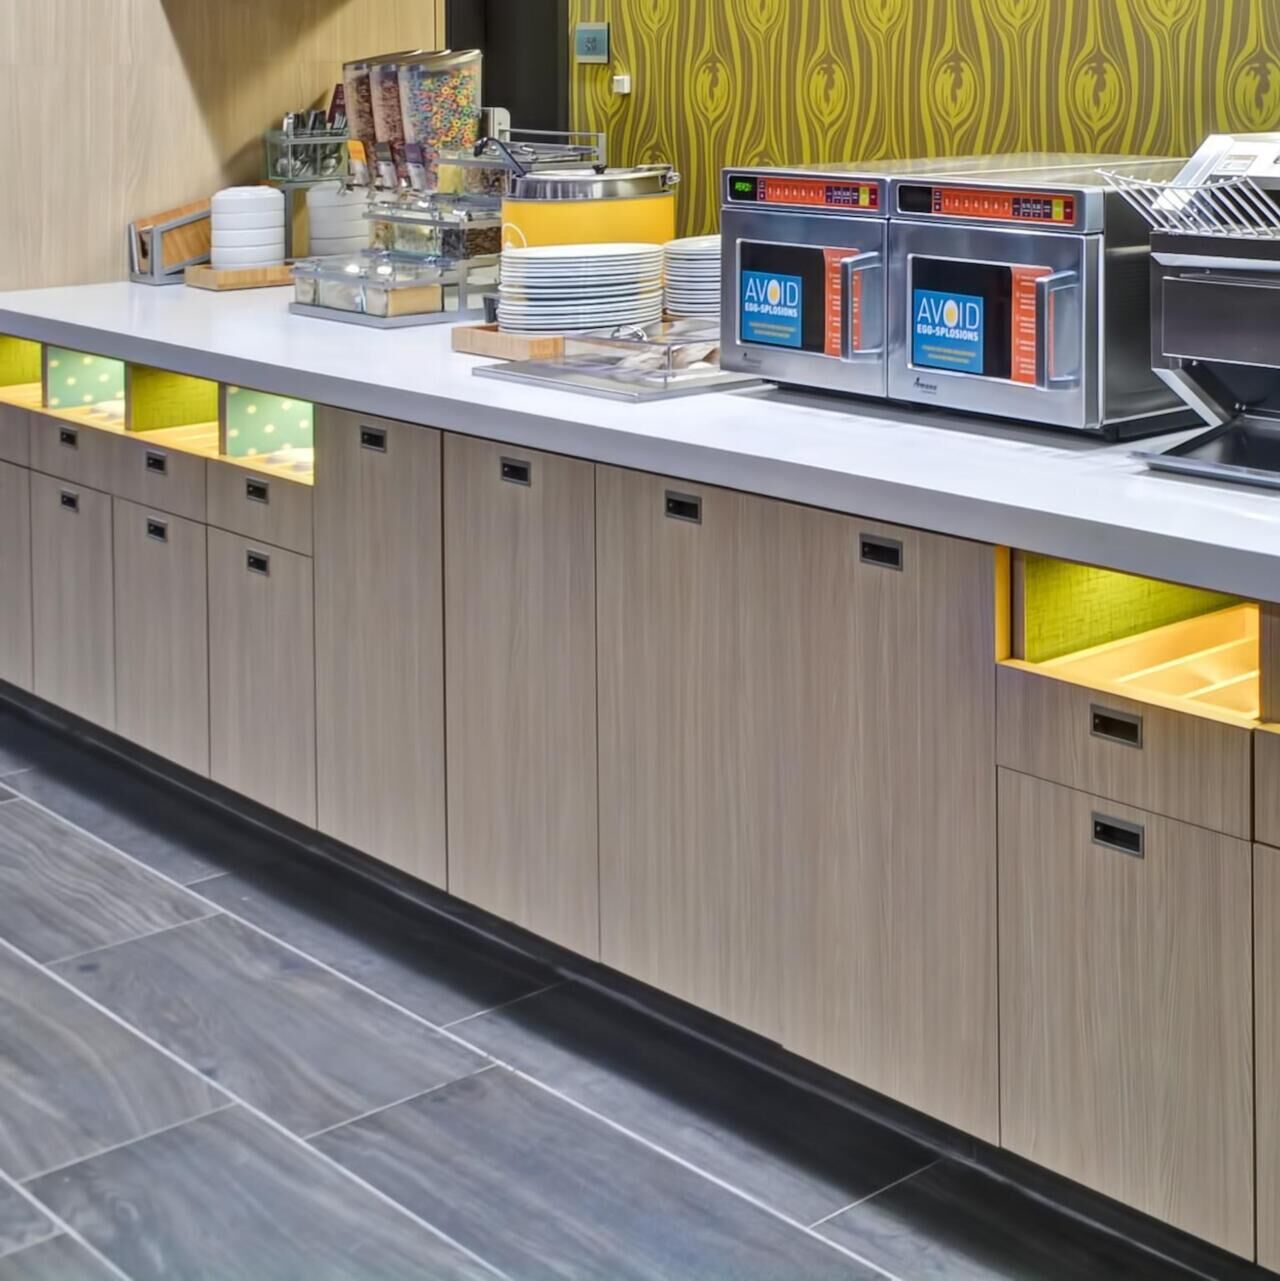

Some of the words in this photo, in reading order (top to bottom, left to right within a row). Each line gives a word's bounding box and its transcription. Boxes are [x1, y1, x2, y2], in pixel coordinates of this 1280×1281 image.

[745, 277, 799, 306] AVOID
[744, 301, 798, 318] EGG-SPLOSIONS
[917, 297, 980, 329] AVOID
[916, 323, 979, 342] EGG-SPLOSIONS
